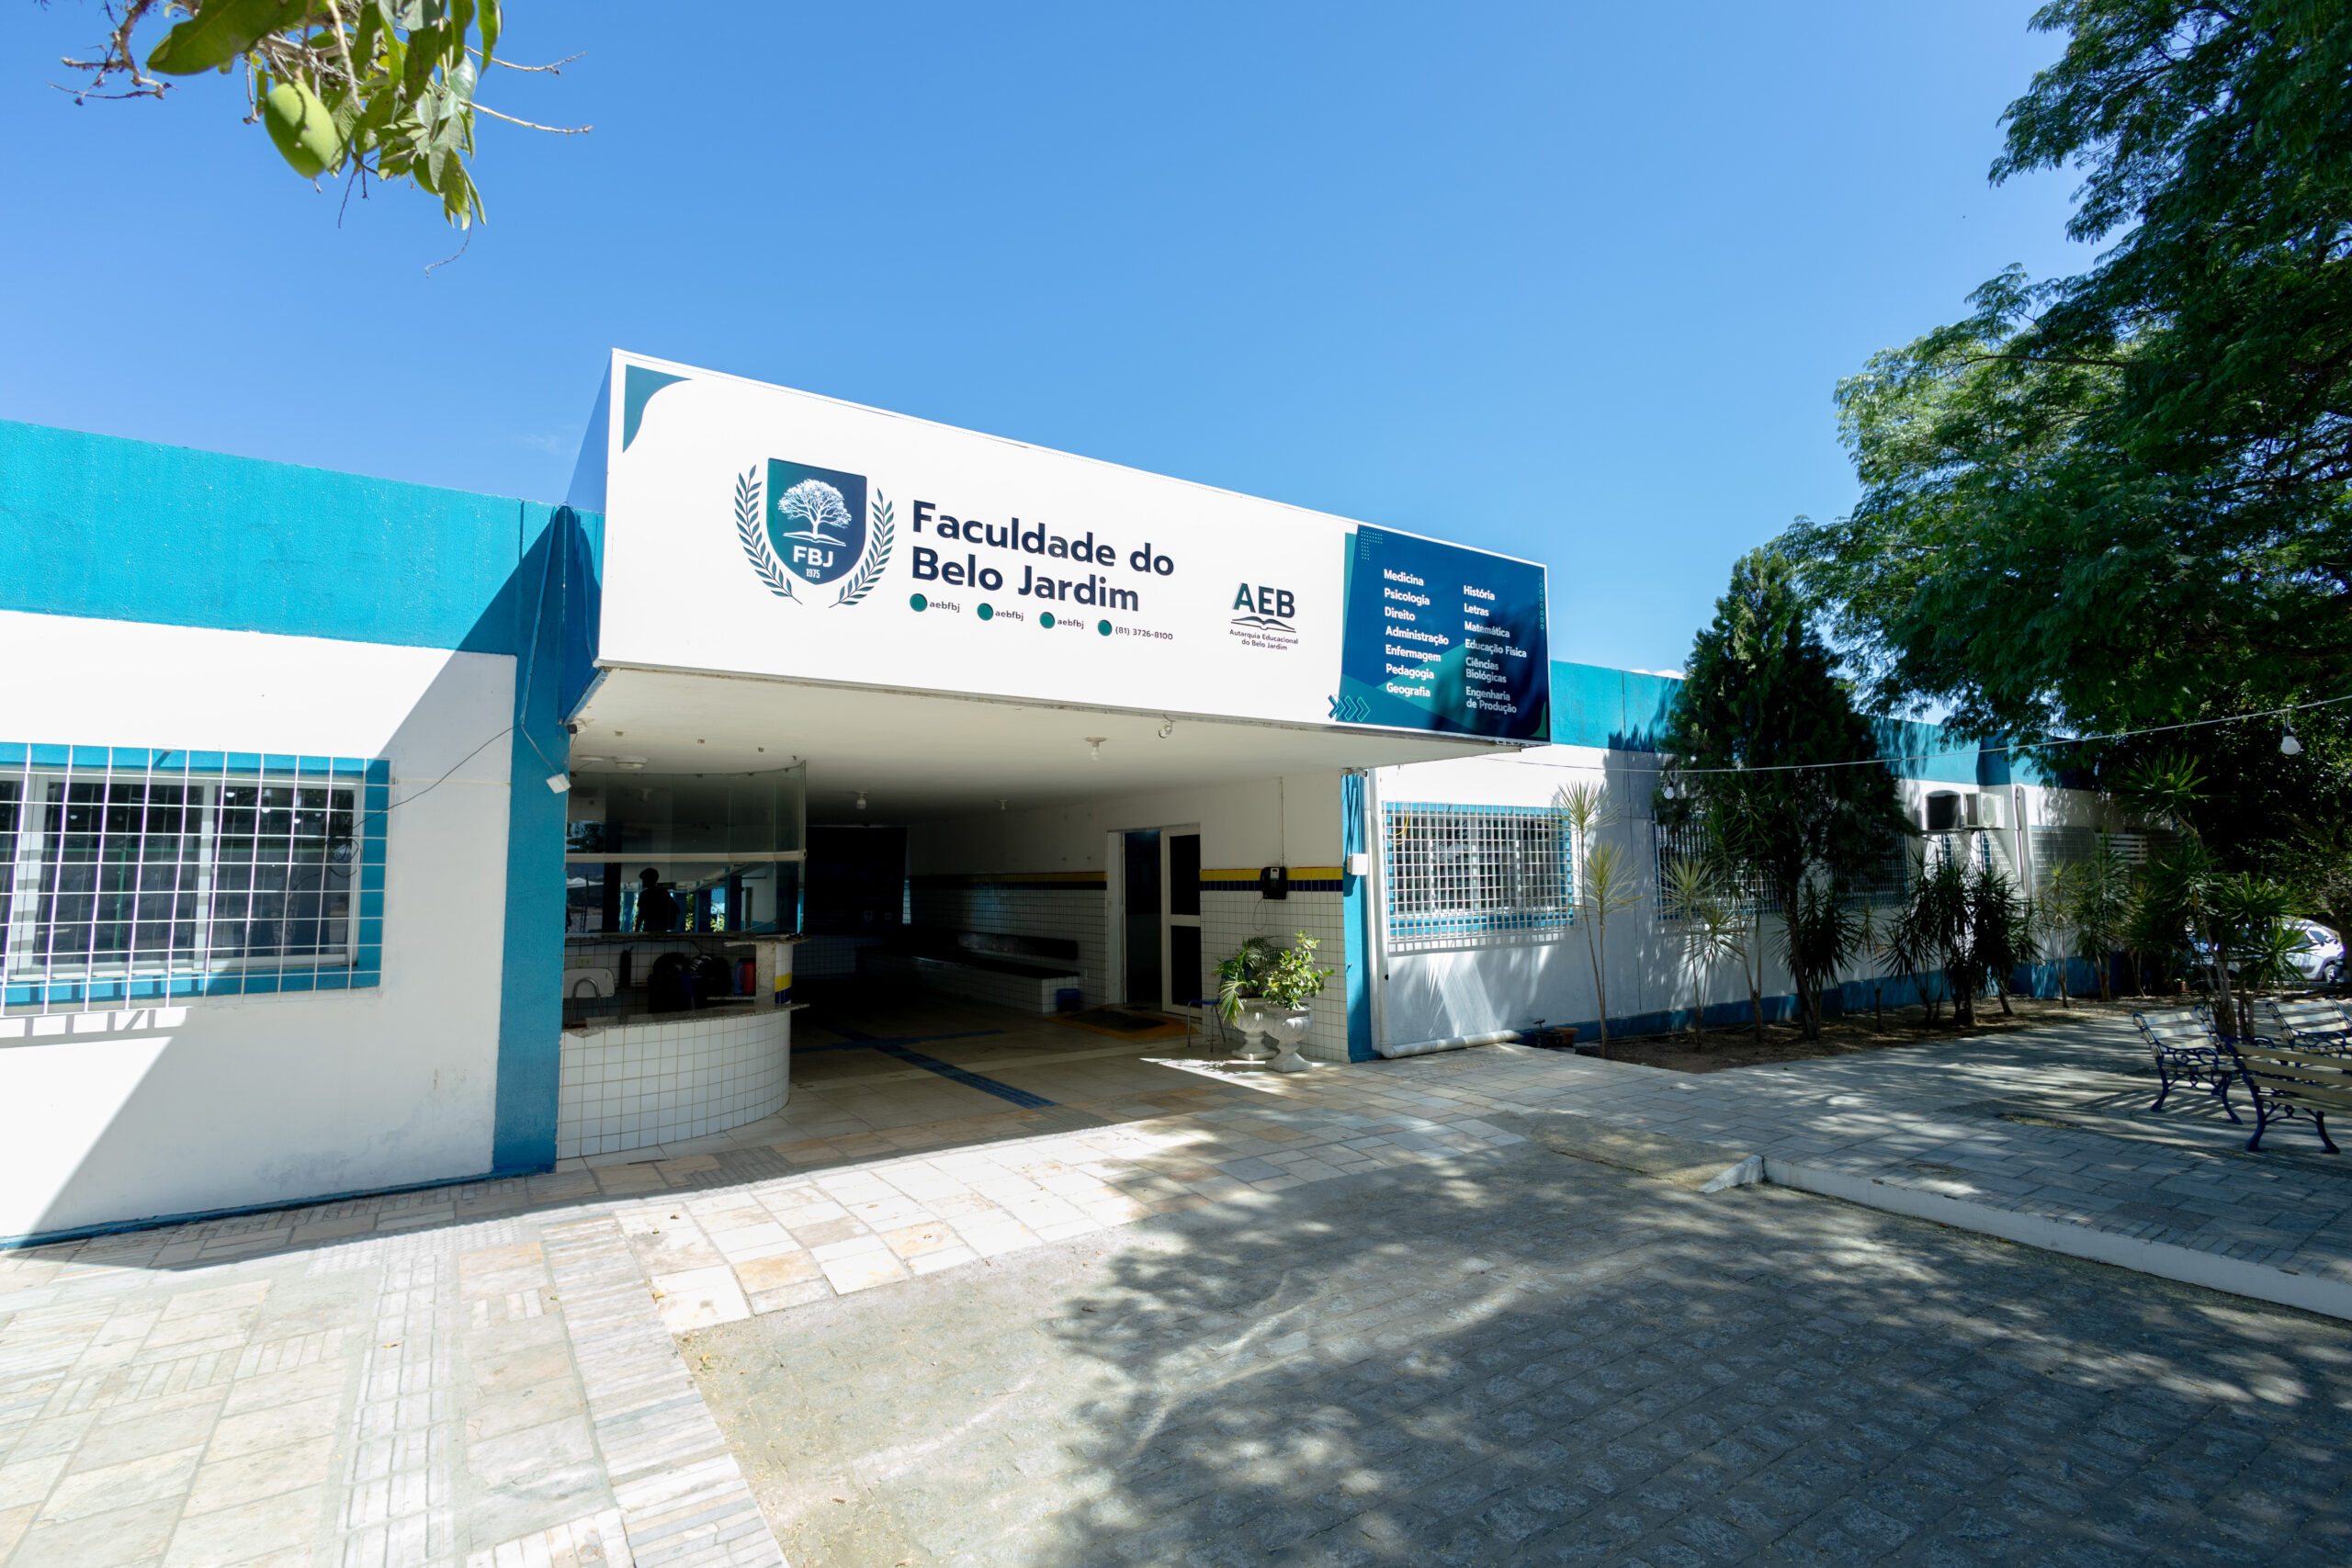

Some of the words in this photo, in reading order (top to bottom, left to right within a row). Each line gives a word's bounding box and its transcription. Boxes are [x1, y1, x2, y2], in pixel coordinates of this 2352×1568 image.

[912, 499, 1116, 567] Faculdade
[1129, 542, 1175, 577] do
[793, 545, 833, 568] FBJ
[806, 568, 820, 579] 1975
[911, 546, 1003, 591] Belo
[1017, 564, 1139, 612] Jardim
[1384, 569, 1424, 586] Medicina
[1232, 582, 1295, 619] AEB
[1384, 588, 1430, 606] Psicologia
[1463, 584, 1495, 601] História
[929, 601, 960, 613] aebfbj
[1384, 606, 1416, 621] Direito
[1464, 603, 1489, 616] Letras
[995, 610, 1024, 622] aebfbj
[1057, 618, 1085, 629] aebfbj
[1114, 626, 1130, 637] (81)
[1132, 628, 1174, 640] 3726-8100
[1229, 629, 1261, 639] Autarquia
[1261, 634, 1299, 645] Educacional
[1385, 626, 1450, 647] Administração
[1464, 621, 1510, 638] Matemática
[1267, 643, 1288, 651] Jardim
[1385, 644, 1442, 662] Enfermagem
[1464, 638, 1504, 655] Educação
[1505, 645, 1527, 658] Física
[1465, 656, 1499, 671] Ciências
[1385, 663, 1435, 681] Pedagogia
[1465, 669, 1507, 683] Biológicas
[1385, 682, 1431, 697] Geografia
[1465, 685, 1510, 701] Engenharia
[1465, 699, 1477, 708] de
[1478, 700, 1517, 715] Produção
